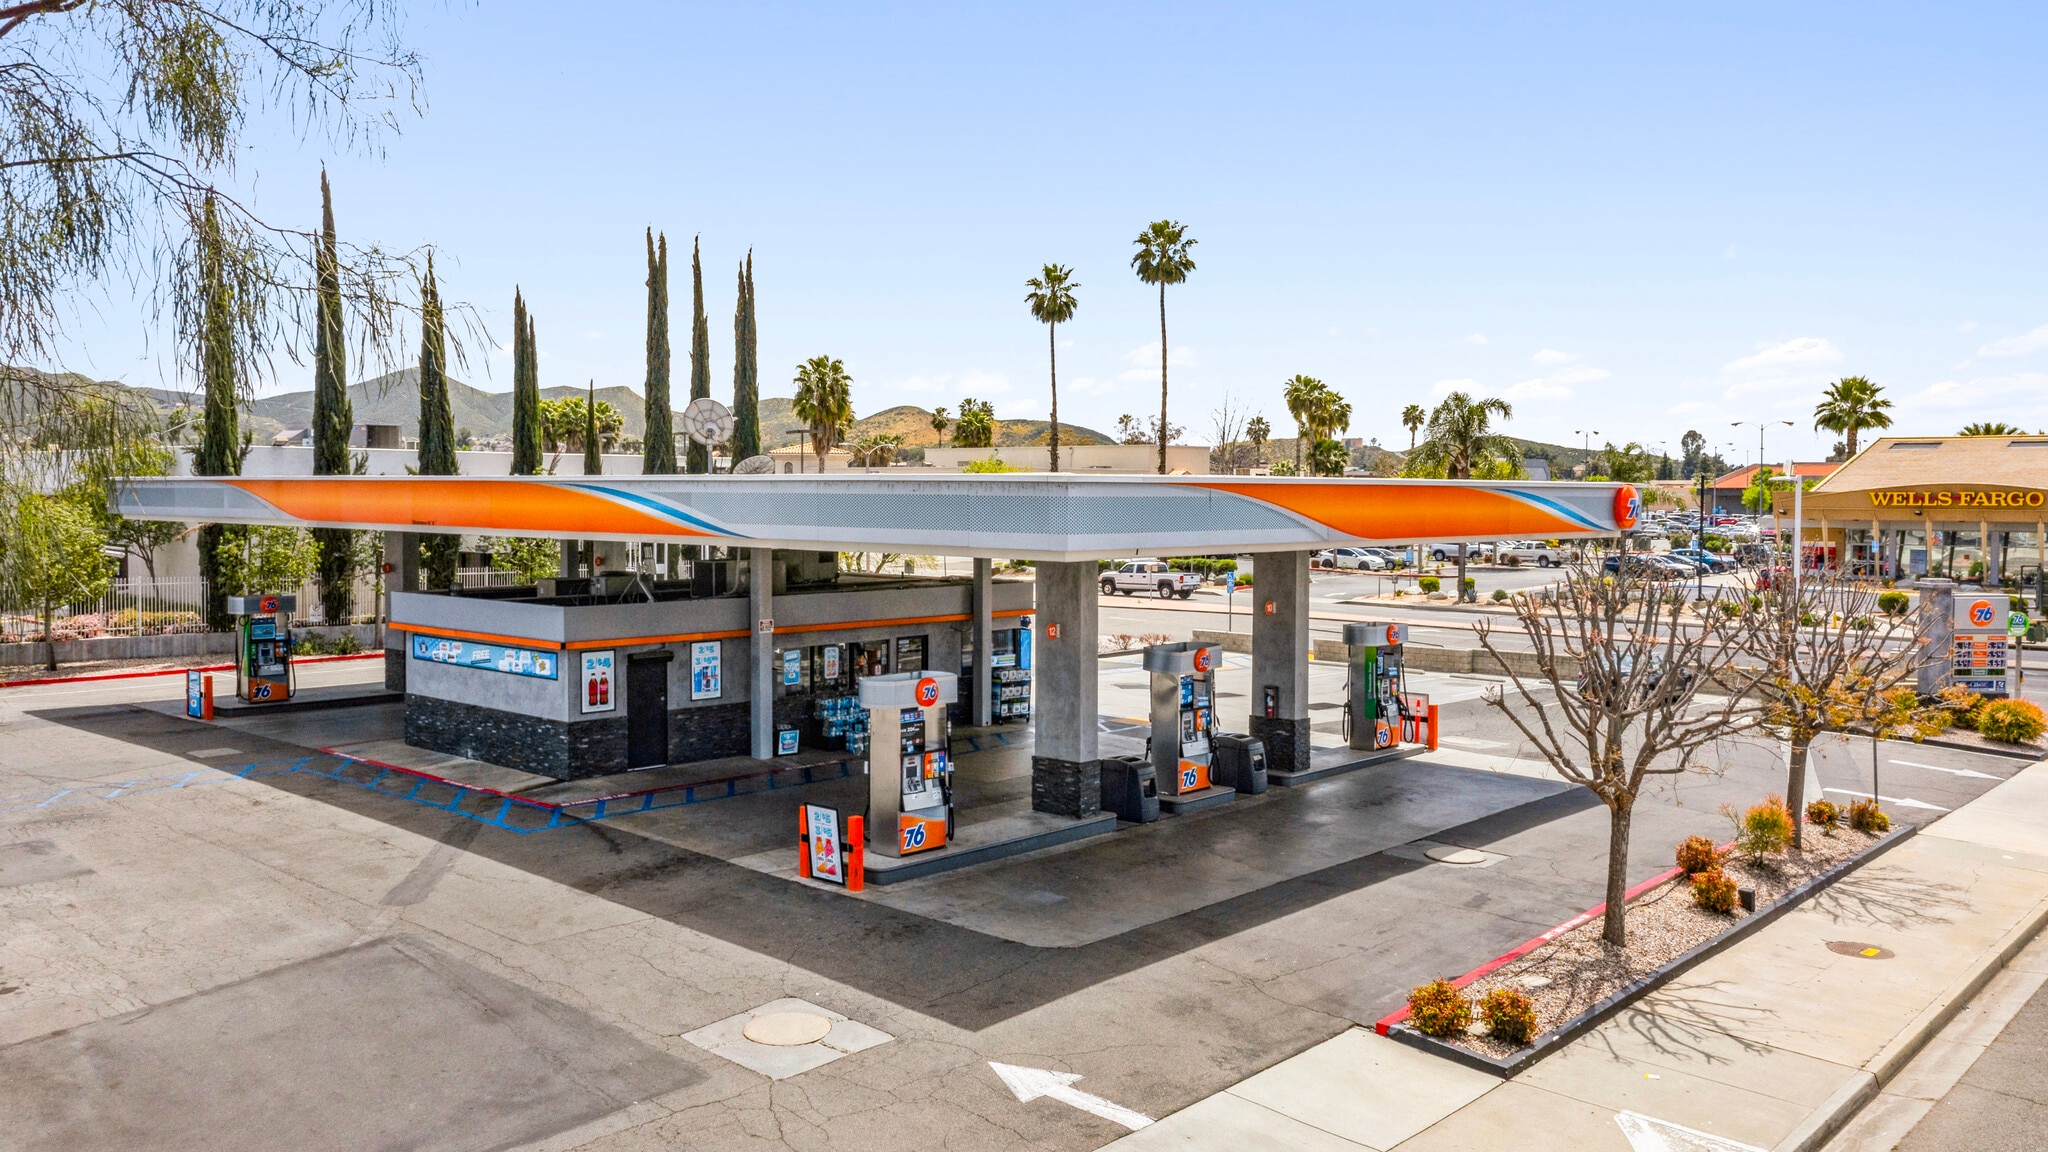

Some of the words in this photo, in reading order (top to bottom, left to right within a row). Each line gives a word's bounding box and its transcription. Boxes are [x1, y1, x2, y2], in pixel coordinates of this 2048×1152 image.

[1868, 491, 1952, 506] WELLS
[1958, 491, 2045, 507] FARGO
[265, 601, 277, 609] 76
[1975, 606, 1993, 622] 76
[2013, 614, 2024, 624] 76
[1049, 626, 1056, 636] 12
[472, 649, 490, 660] FREE
[1200, 656, 1209, 666] 76
[253, 684, 272, 700] 76
[922, 685, 937, 699] 76
[1377, 728, 1389, 744] 76
[1182, 767, 1197, 789] 76
[904, 822, 926, 849] 76
